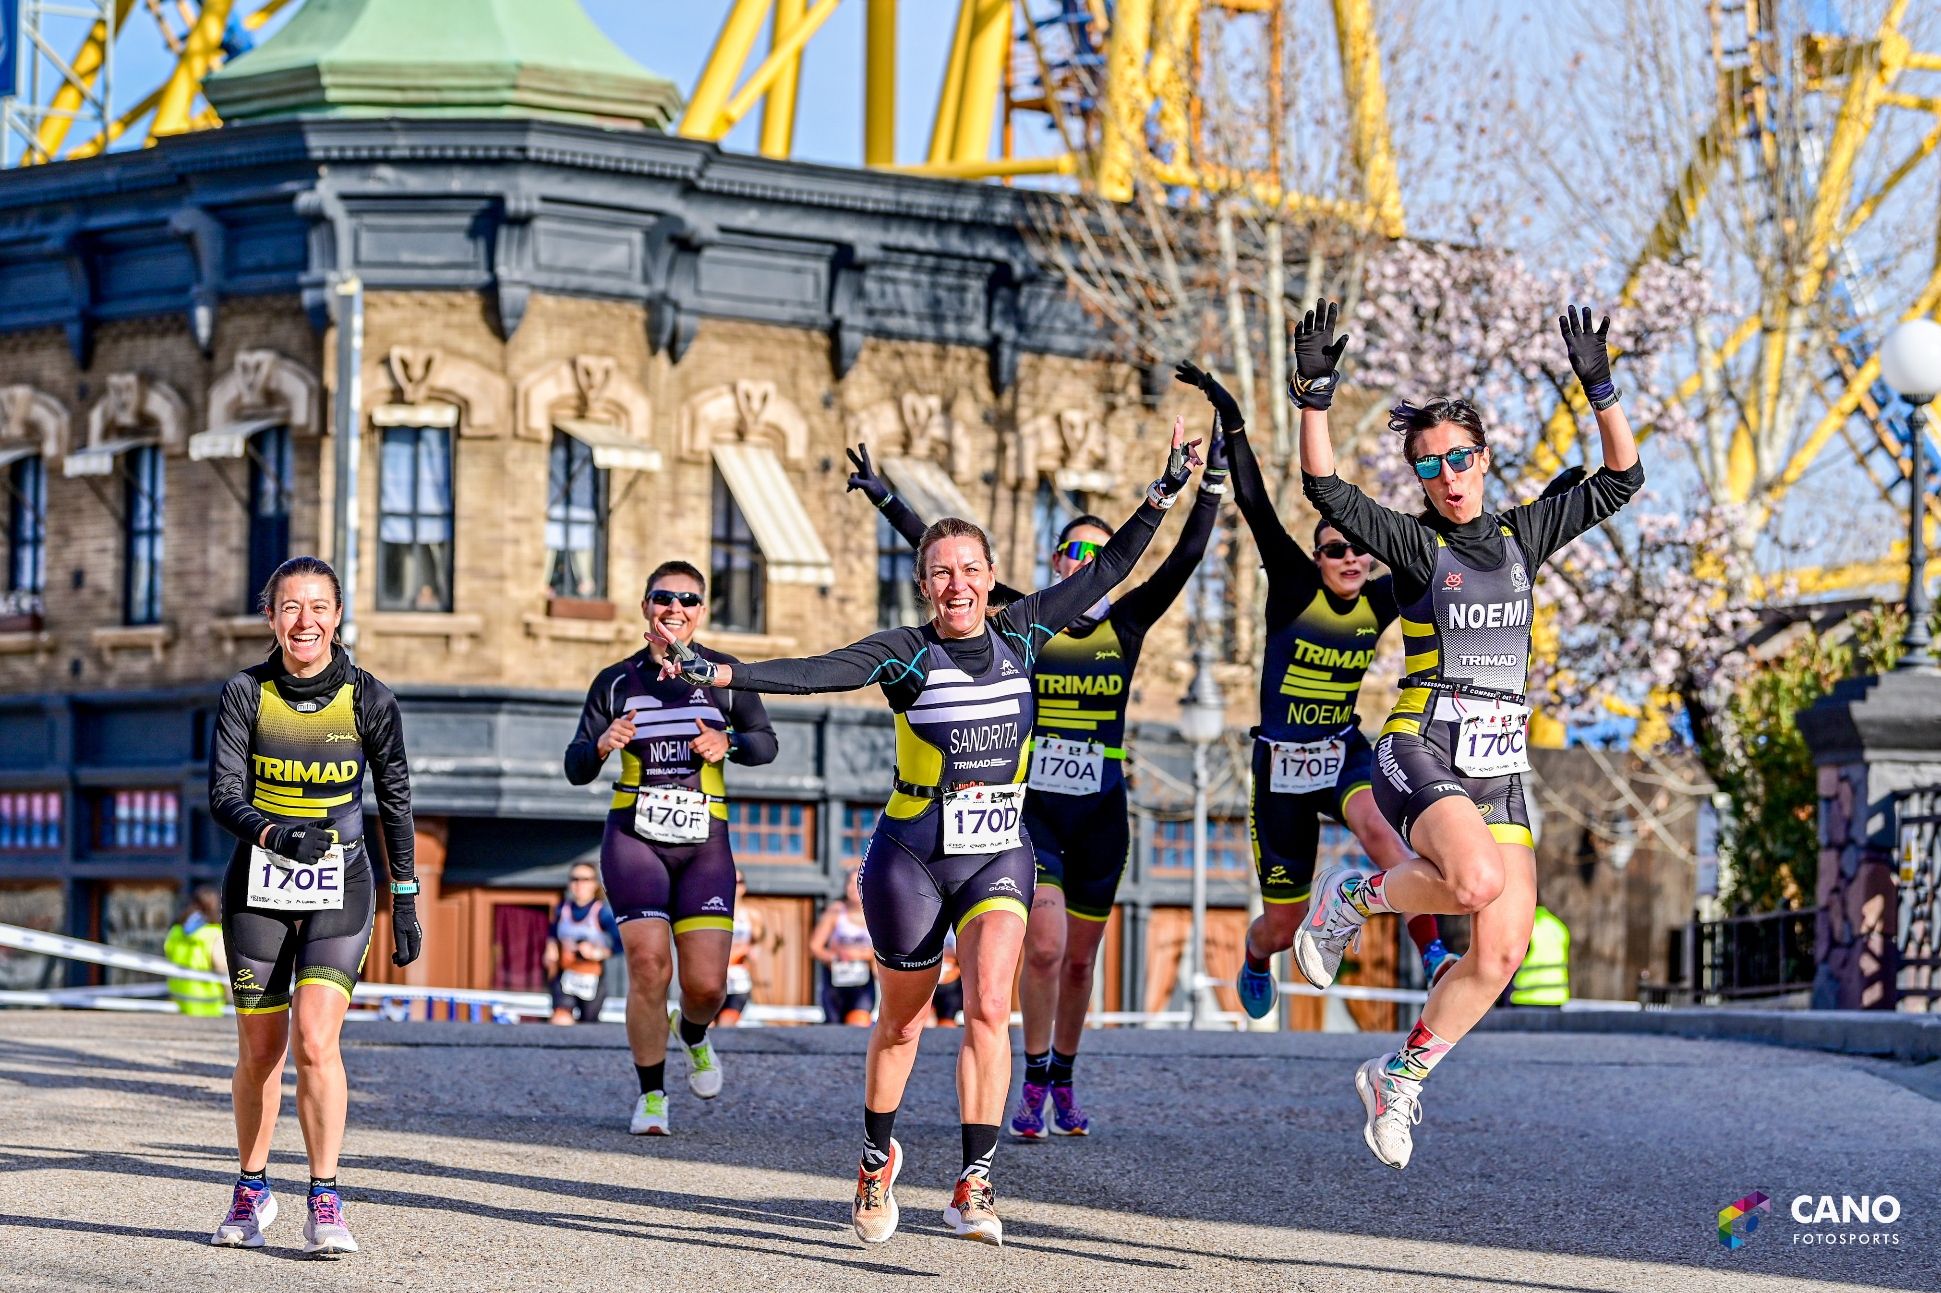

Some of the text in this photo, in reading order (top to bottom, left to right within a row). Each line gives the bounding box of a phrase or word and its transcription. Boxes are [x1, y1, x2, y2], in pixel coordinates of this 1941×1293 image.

[1448, 598, 1528, 629] NOEMI
[1459, 655, 1517, 666] TRIMAD
[1035, 673, 1123, 695] TRIMAD
[1287, 702, 1353, 725] NOEMI
[949, 721, 1018, 755] SANDRITA
[1468, 729, 1523, 758] 170C
[649, 740, 691, 763] NOEMI
[1377, 734, 1400, 778] TRIMAD
[253, 754, 358, 783] TRIMAD
[646, 768, 677, 776] TRIMAD
[953, 759, 990, 770] TRIMAD
[1040, 756, 1096, 781] 170A
[1281, 758, 1340, 777] 170B
[646, 805, 705, 829] 170F
[955, 808, 1018, 834] 170D
[262, 863, 339, 891] 170E
[901, 955, 938, 968] TRIMAD
